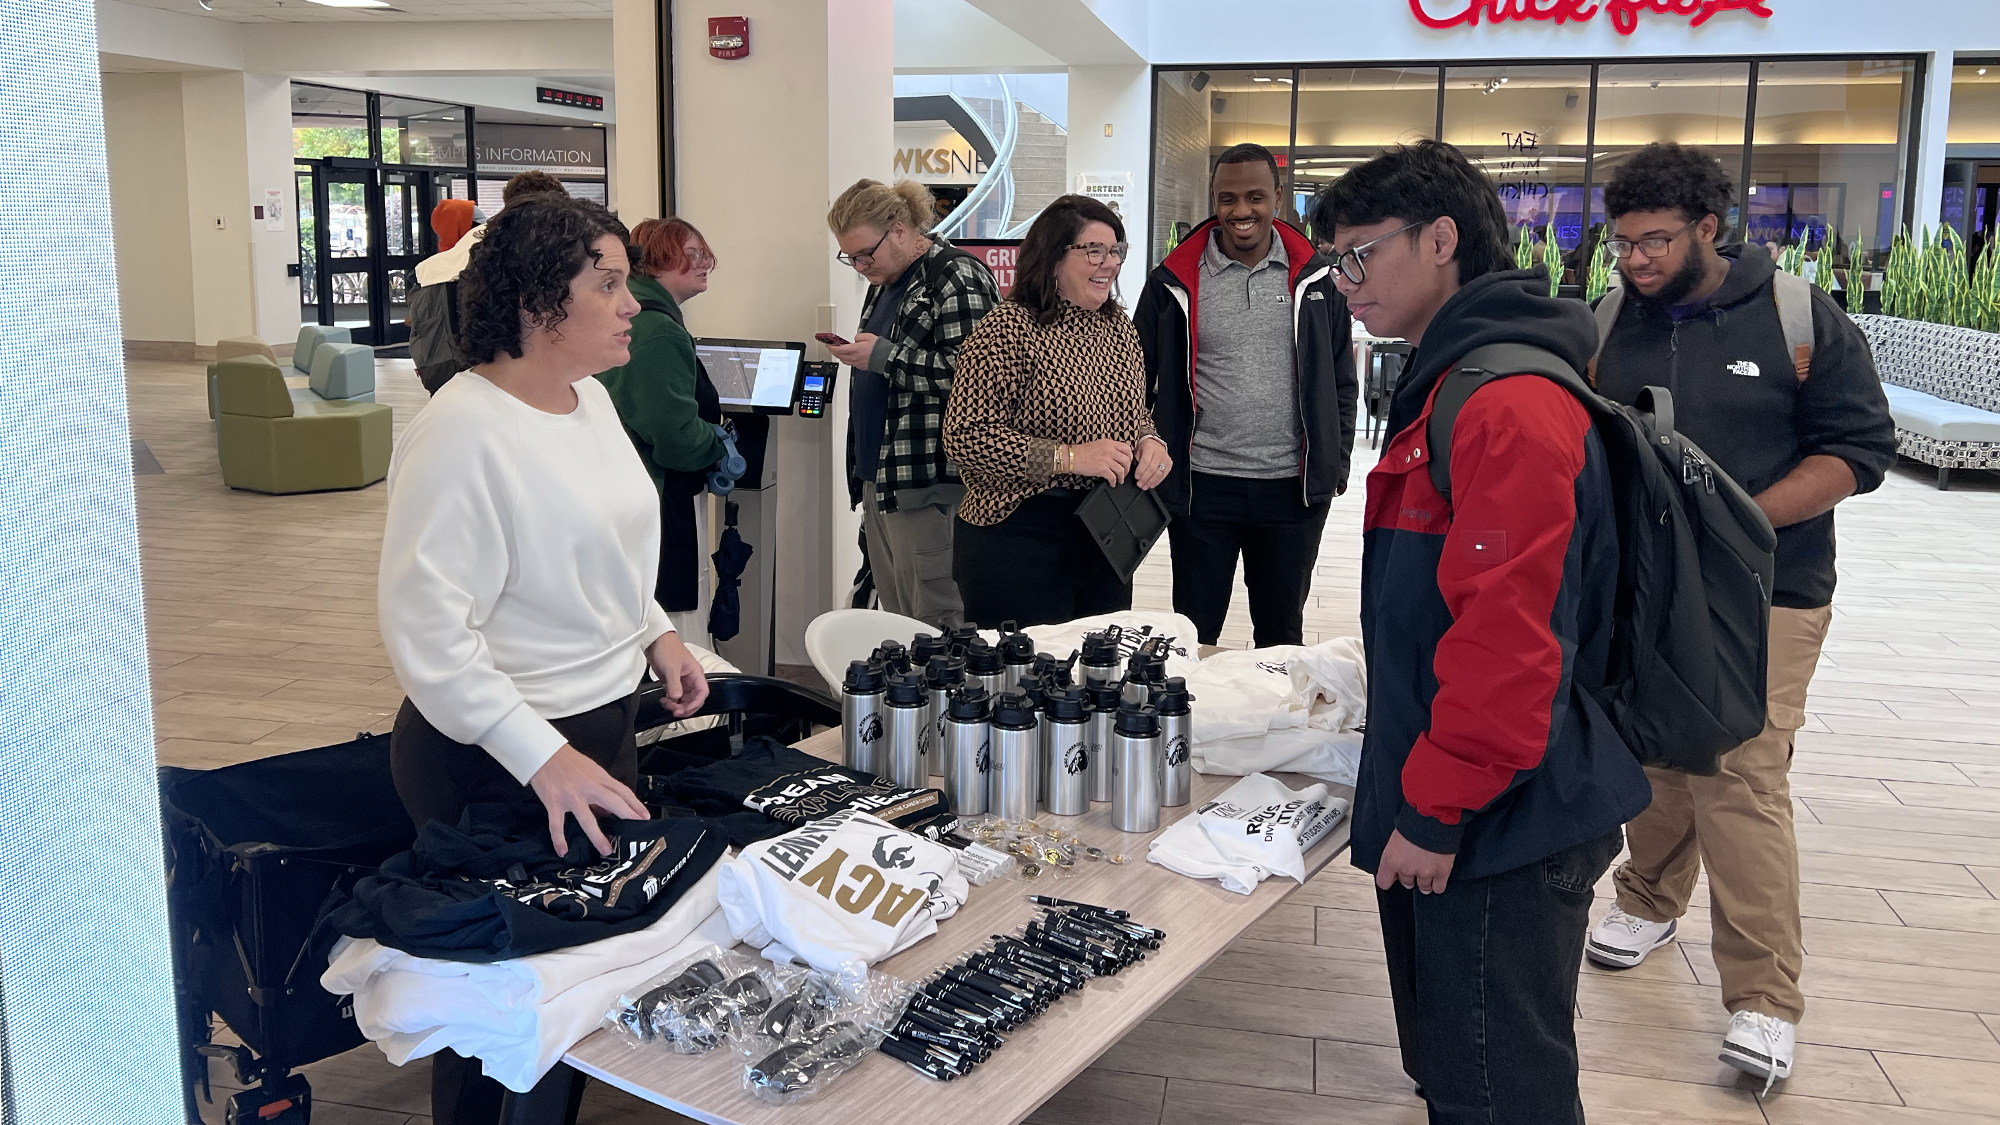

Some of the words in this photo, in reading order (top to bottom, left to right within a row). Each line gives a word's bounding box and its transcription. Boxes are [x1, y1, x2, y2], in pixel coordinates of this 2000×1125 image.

[485, 147, 591, 163] INFORMATION
[1303, 821, 1325, 841] STUDENT
[1321, 808, 1341, 826] AFFAIRS
[760, 824, 829, 881] LEAVE
[661, 856, 687, 886] CAREER
[798, 847, 926, 928] ACY
